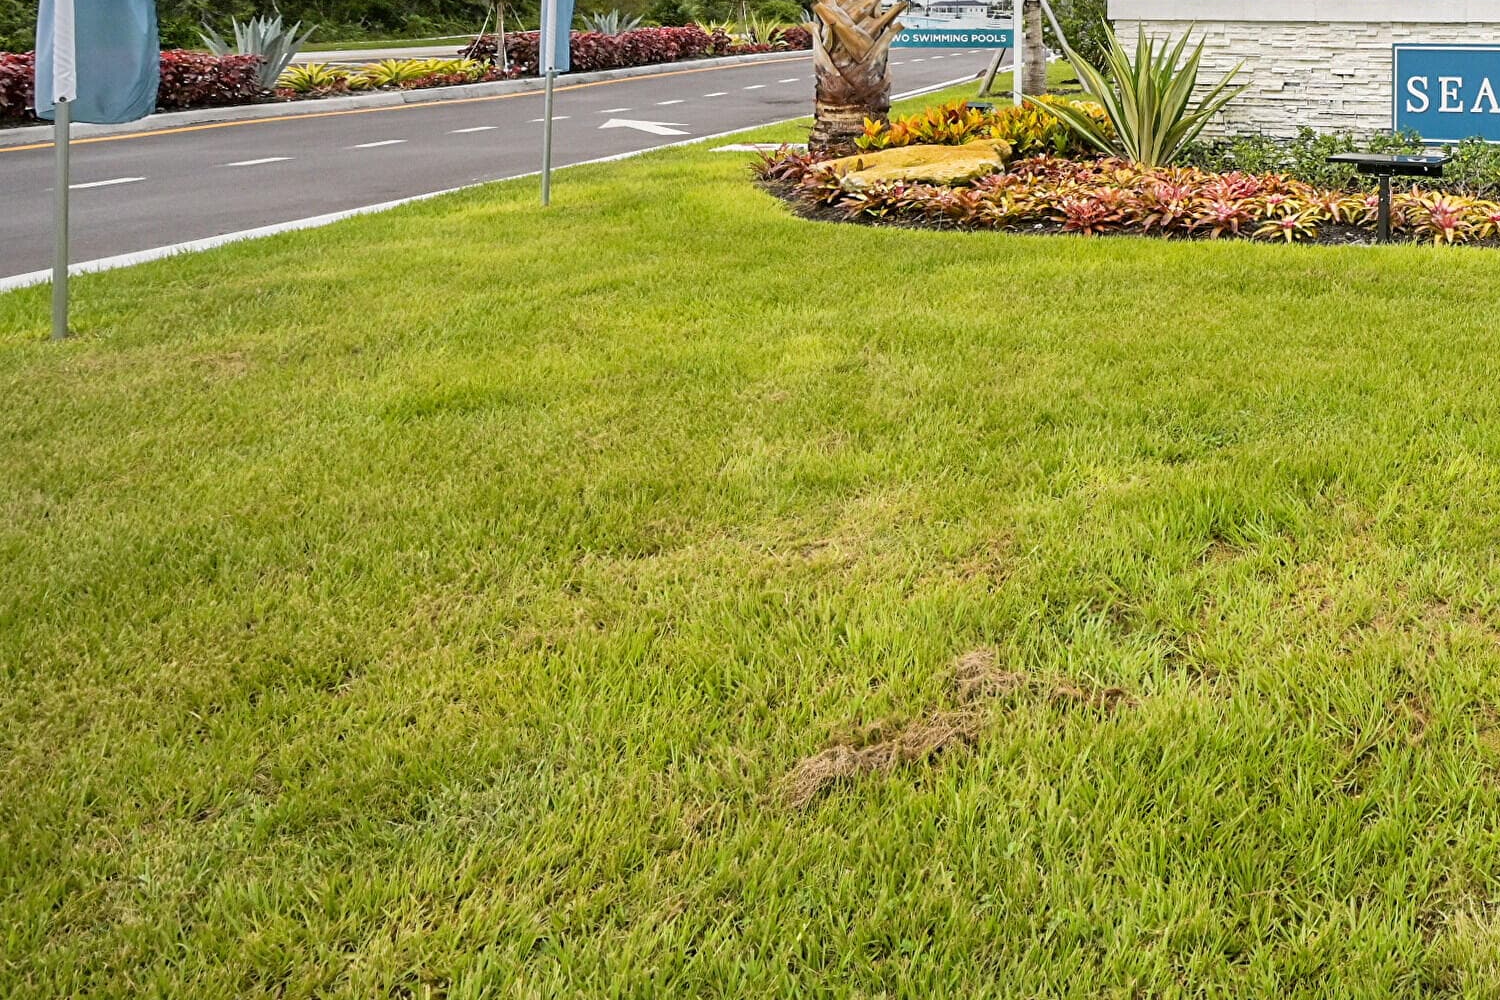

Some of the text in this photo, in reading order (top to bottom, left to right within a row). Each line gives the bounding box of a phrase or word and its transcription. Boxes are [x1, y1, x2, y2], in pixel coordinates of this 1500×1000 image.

[892, 33, 1007, 43] WO SWIMMING POOLS
